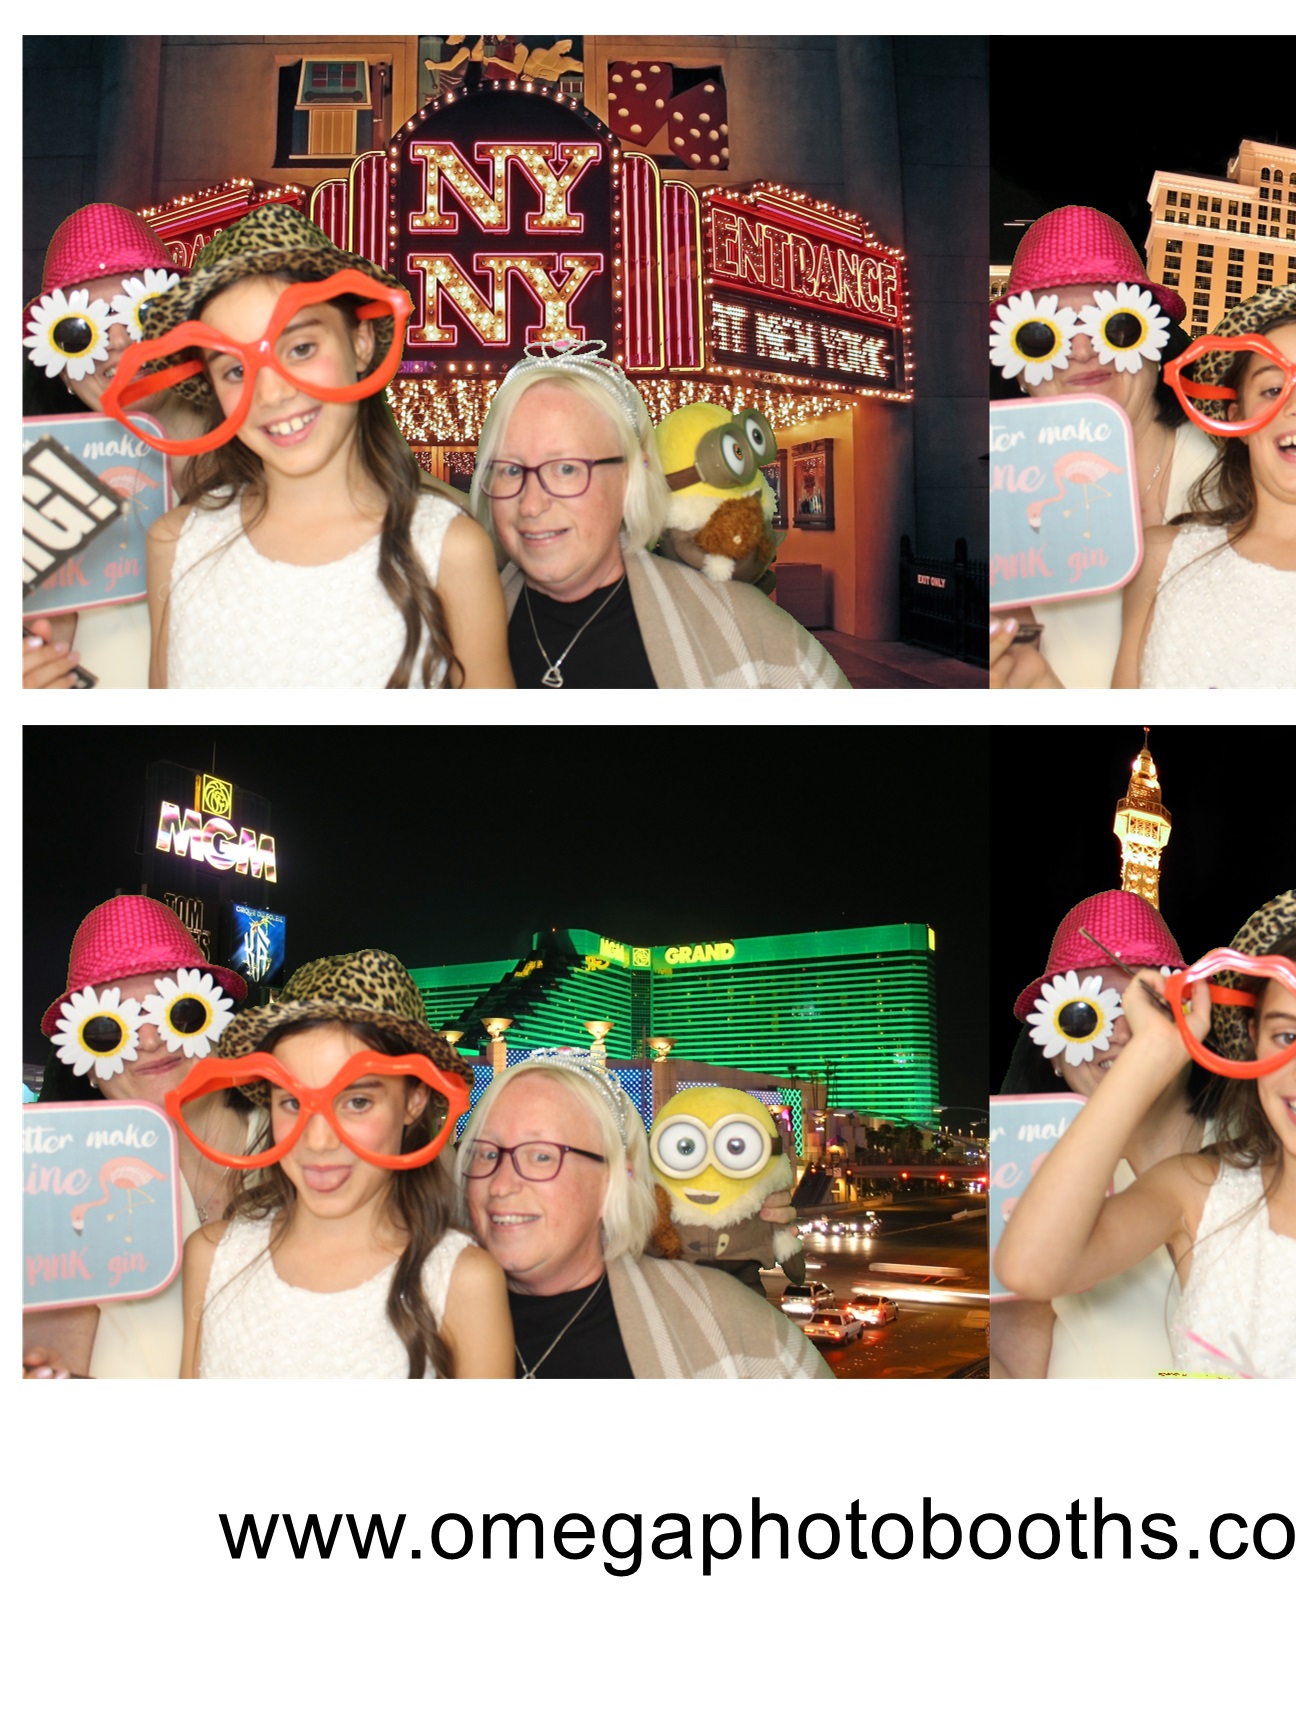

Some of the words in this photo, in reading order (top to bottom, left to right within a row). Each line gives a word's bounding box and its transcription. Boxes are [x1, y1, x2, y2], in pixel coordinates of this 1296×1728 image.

[409, 140, 602, 234] NY
[712, 208, 897, 317] ENTRANCE
[407, 252, 604, 346] NY
[755, 311, 819, 367] NEW
[1038, 418, 1112, 445] make
[1066, 547, 1109, 585] gin
[155, 801, 277, 883] MGM
[235, 905, 256, 917] CIRQUE
[664, 942, 735, 964] GRAND
[86, 1123, 159, 1149] make
[107, 1250, 149, 1288] gin
